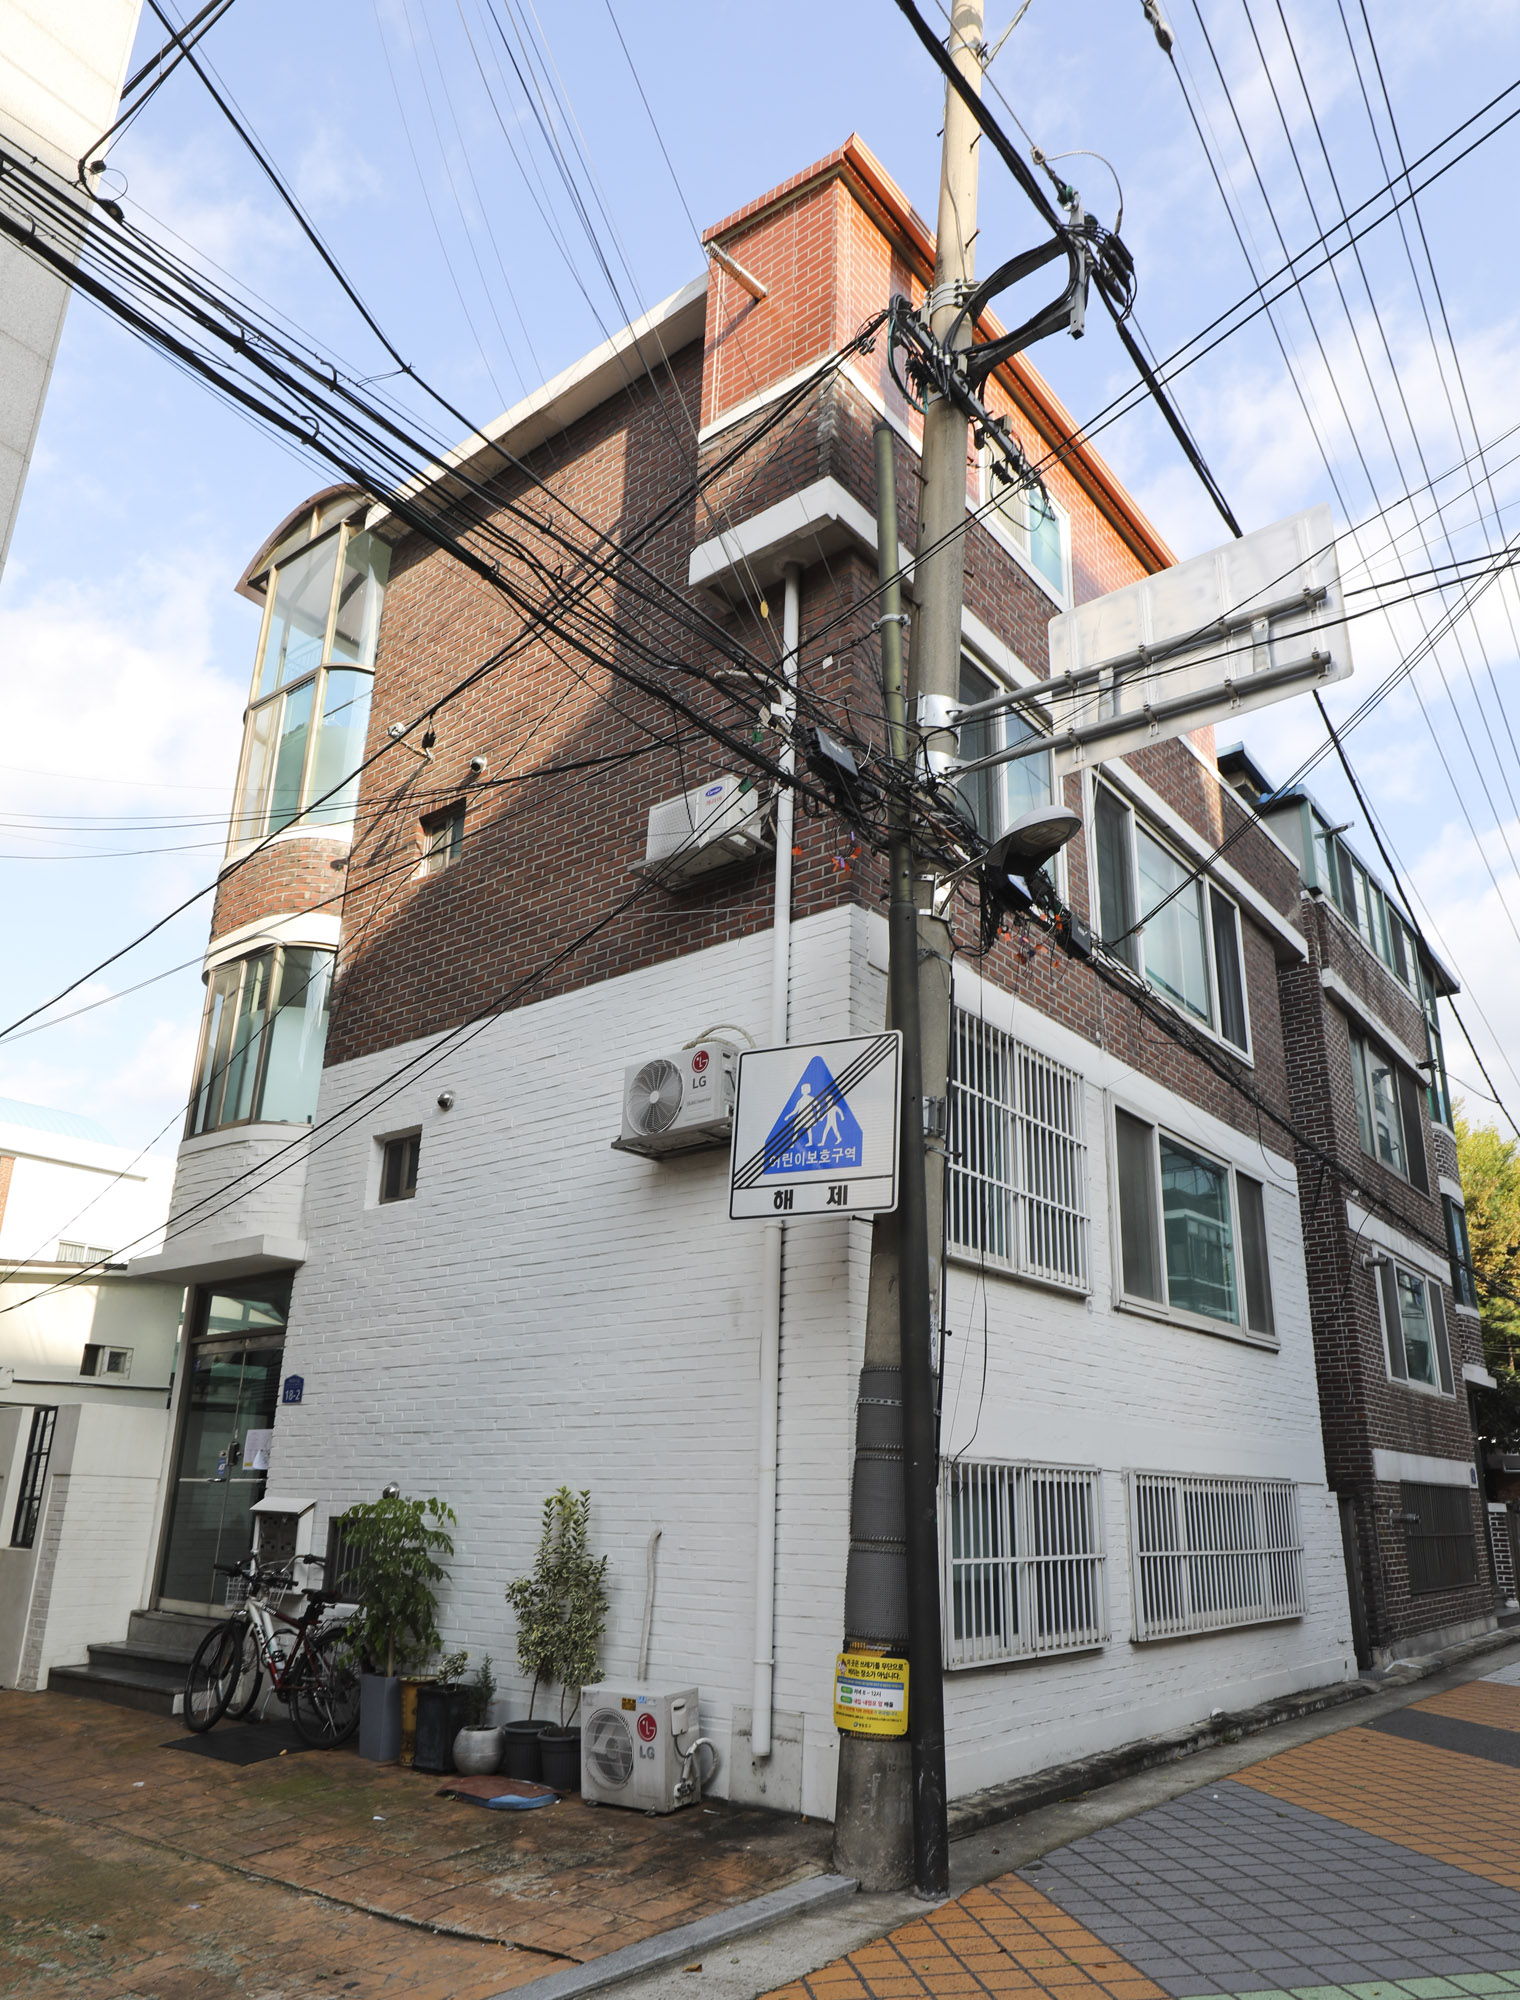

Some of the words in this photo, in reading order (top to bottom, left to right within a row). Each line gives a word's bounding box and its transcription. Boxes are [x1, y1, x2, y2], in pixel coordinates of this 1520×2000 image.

[692, 1075, 707, 1089] LG
[769, 1146, 856, 1169] 어린이보호구역
[773, 1189, 794, 1210] 해
[826, 1185, 848, 1206] 제
[285, 1389, 301, 1401] 18-2
[639, 1745, 655, 1760] LG
